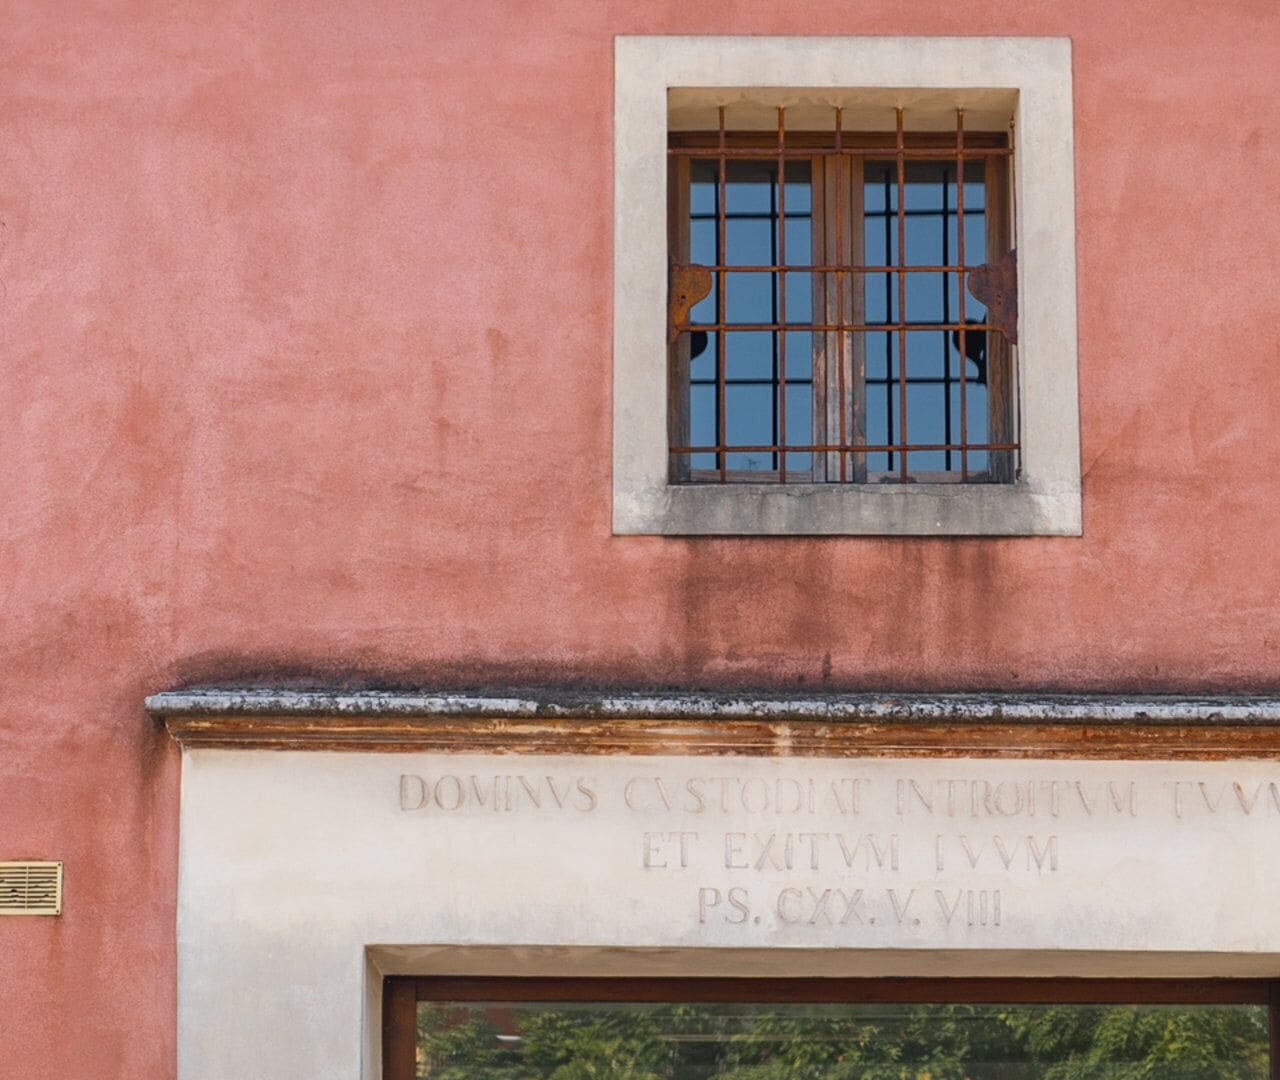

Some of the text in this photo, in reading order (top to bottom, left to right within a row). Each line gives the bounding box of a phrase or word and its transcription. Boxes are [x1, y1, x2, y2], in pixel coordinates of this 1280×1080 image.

[399, 774, 598, 813] DOMINVS
[895, 778, 1139, 818] INTROITVM
[642, 831, 699, 869] ET
[724, 831, 900, 872] EXITVM
[697, 886, 1001, 927] PS. CXX. V. VIII
